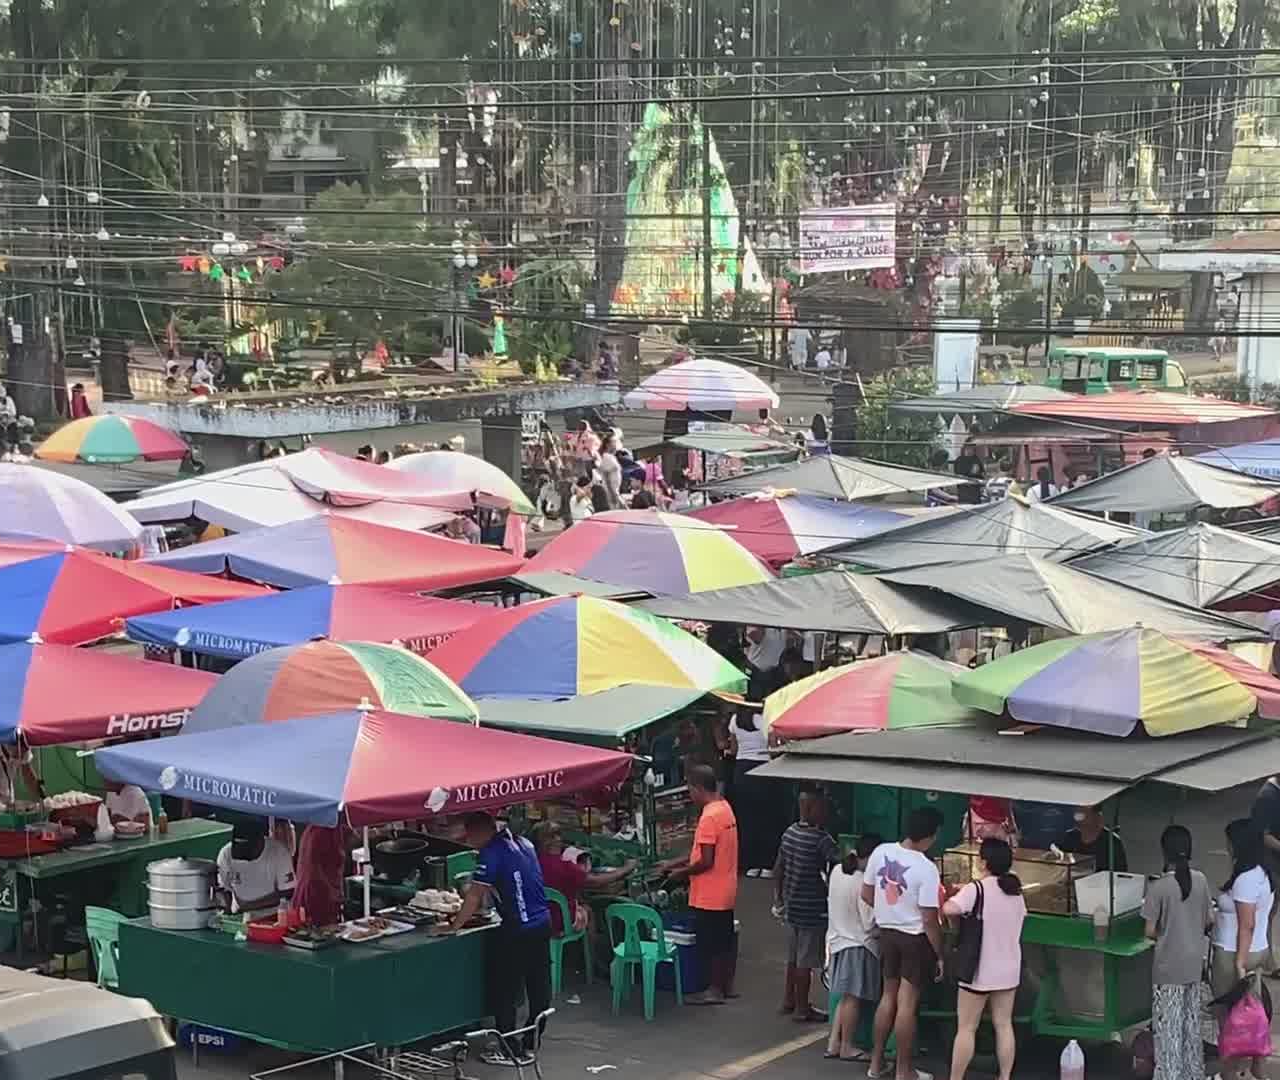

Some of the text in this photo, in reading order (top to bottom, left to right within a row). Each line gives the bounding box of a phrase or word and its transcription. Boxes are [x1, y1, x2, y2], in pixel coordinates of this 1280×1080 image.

[106, 708, 192, 735] Homst
[183, 774, 277, 808] MICROMATIC
[455, 770, 564, 803] MICROMATIC
